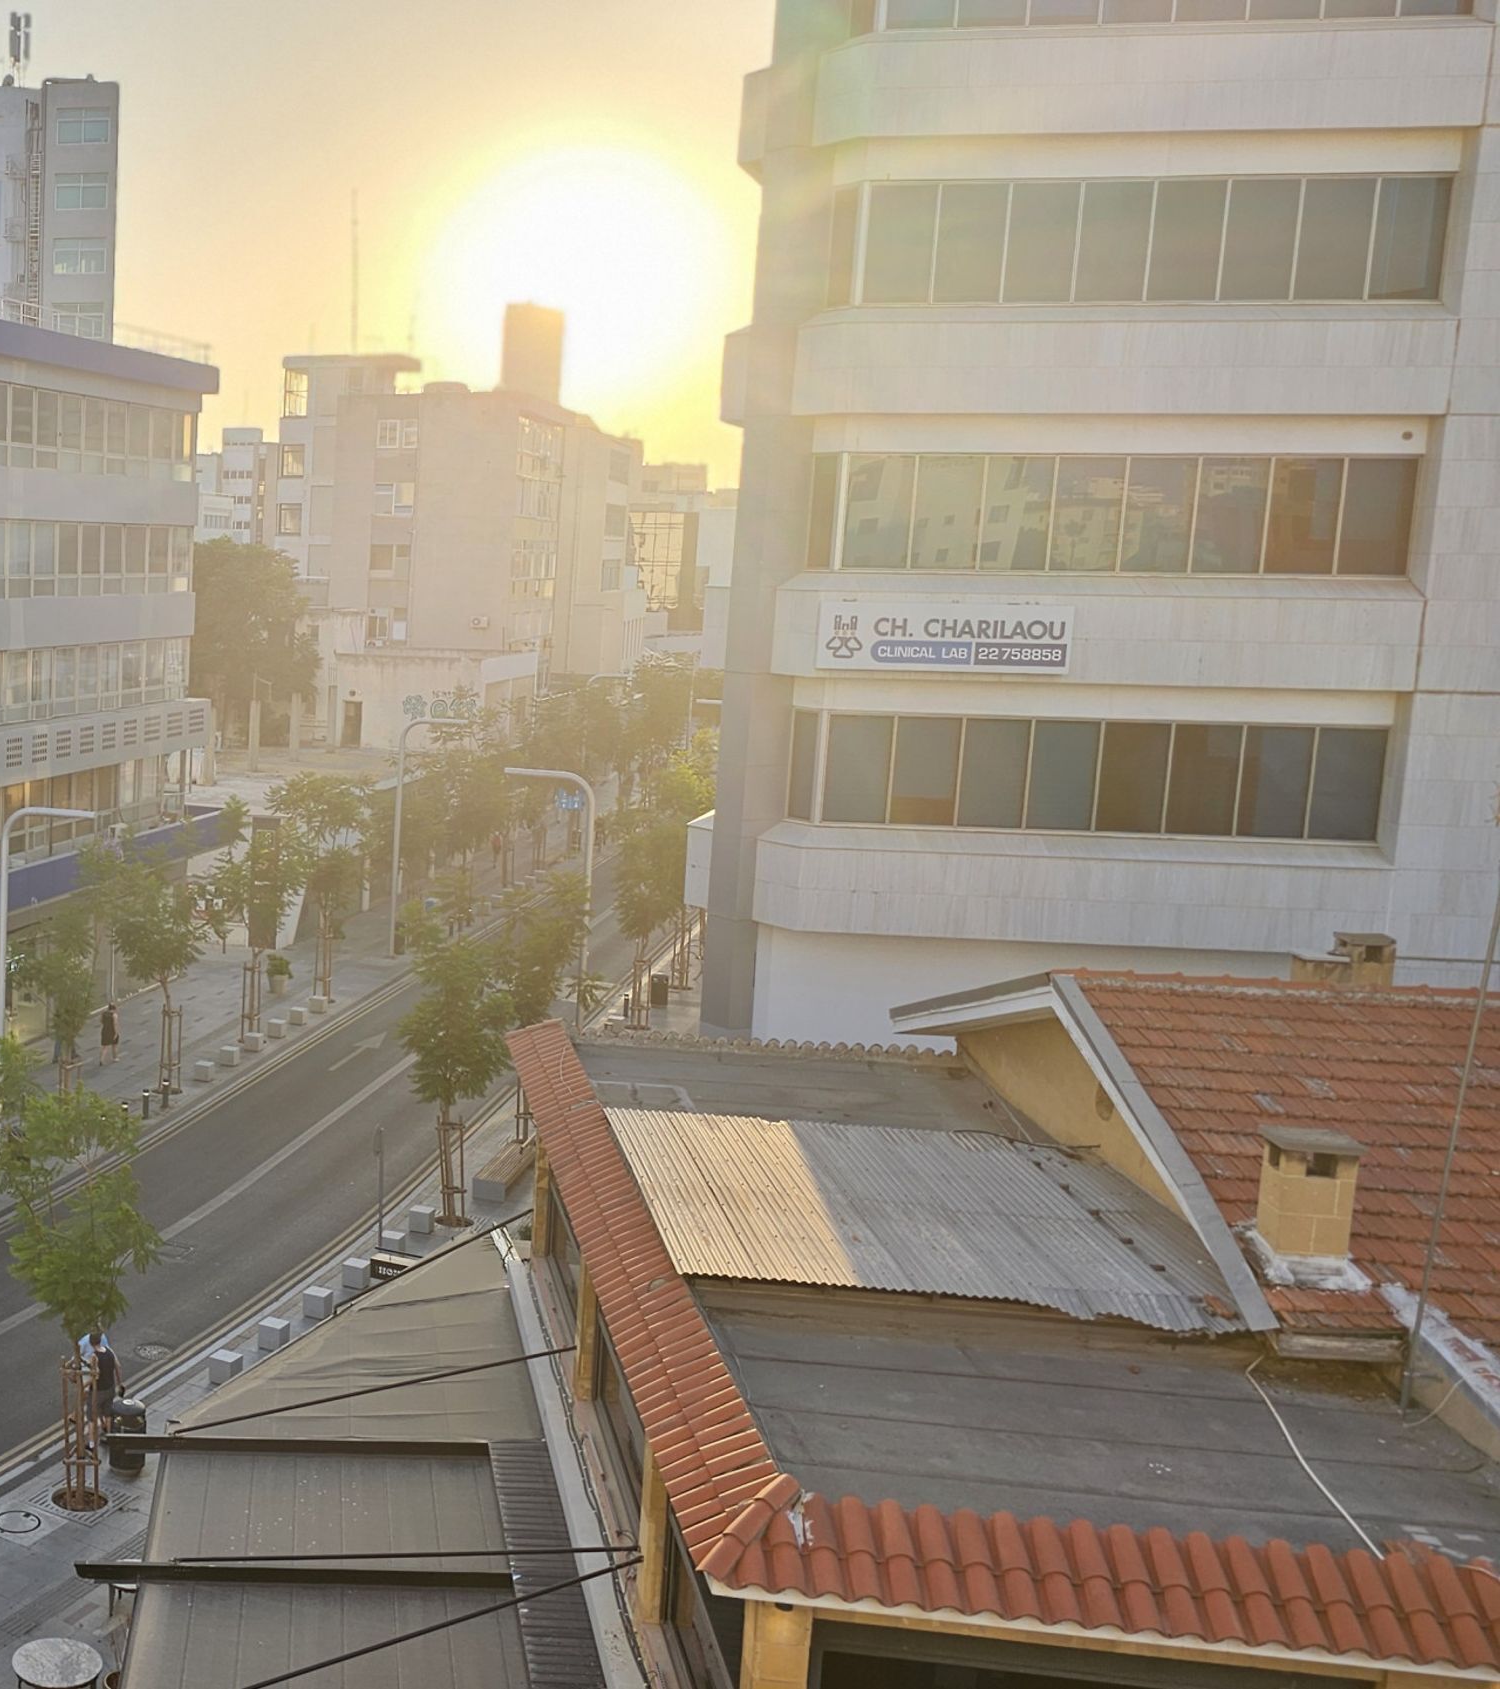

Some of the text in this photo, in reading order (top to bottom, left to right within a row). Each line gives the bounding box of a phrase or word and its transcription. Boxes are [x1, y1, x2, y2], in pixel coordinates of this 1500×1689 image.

[873, 617, 1067, 641] CH. CHARILAOU
[877, 645, 969, 660] CLINICAL LAB
